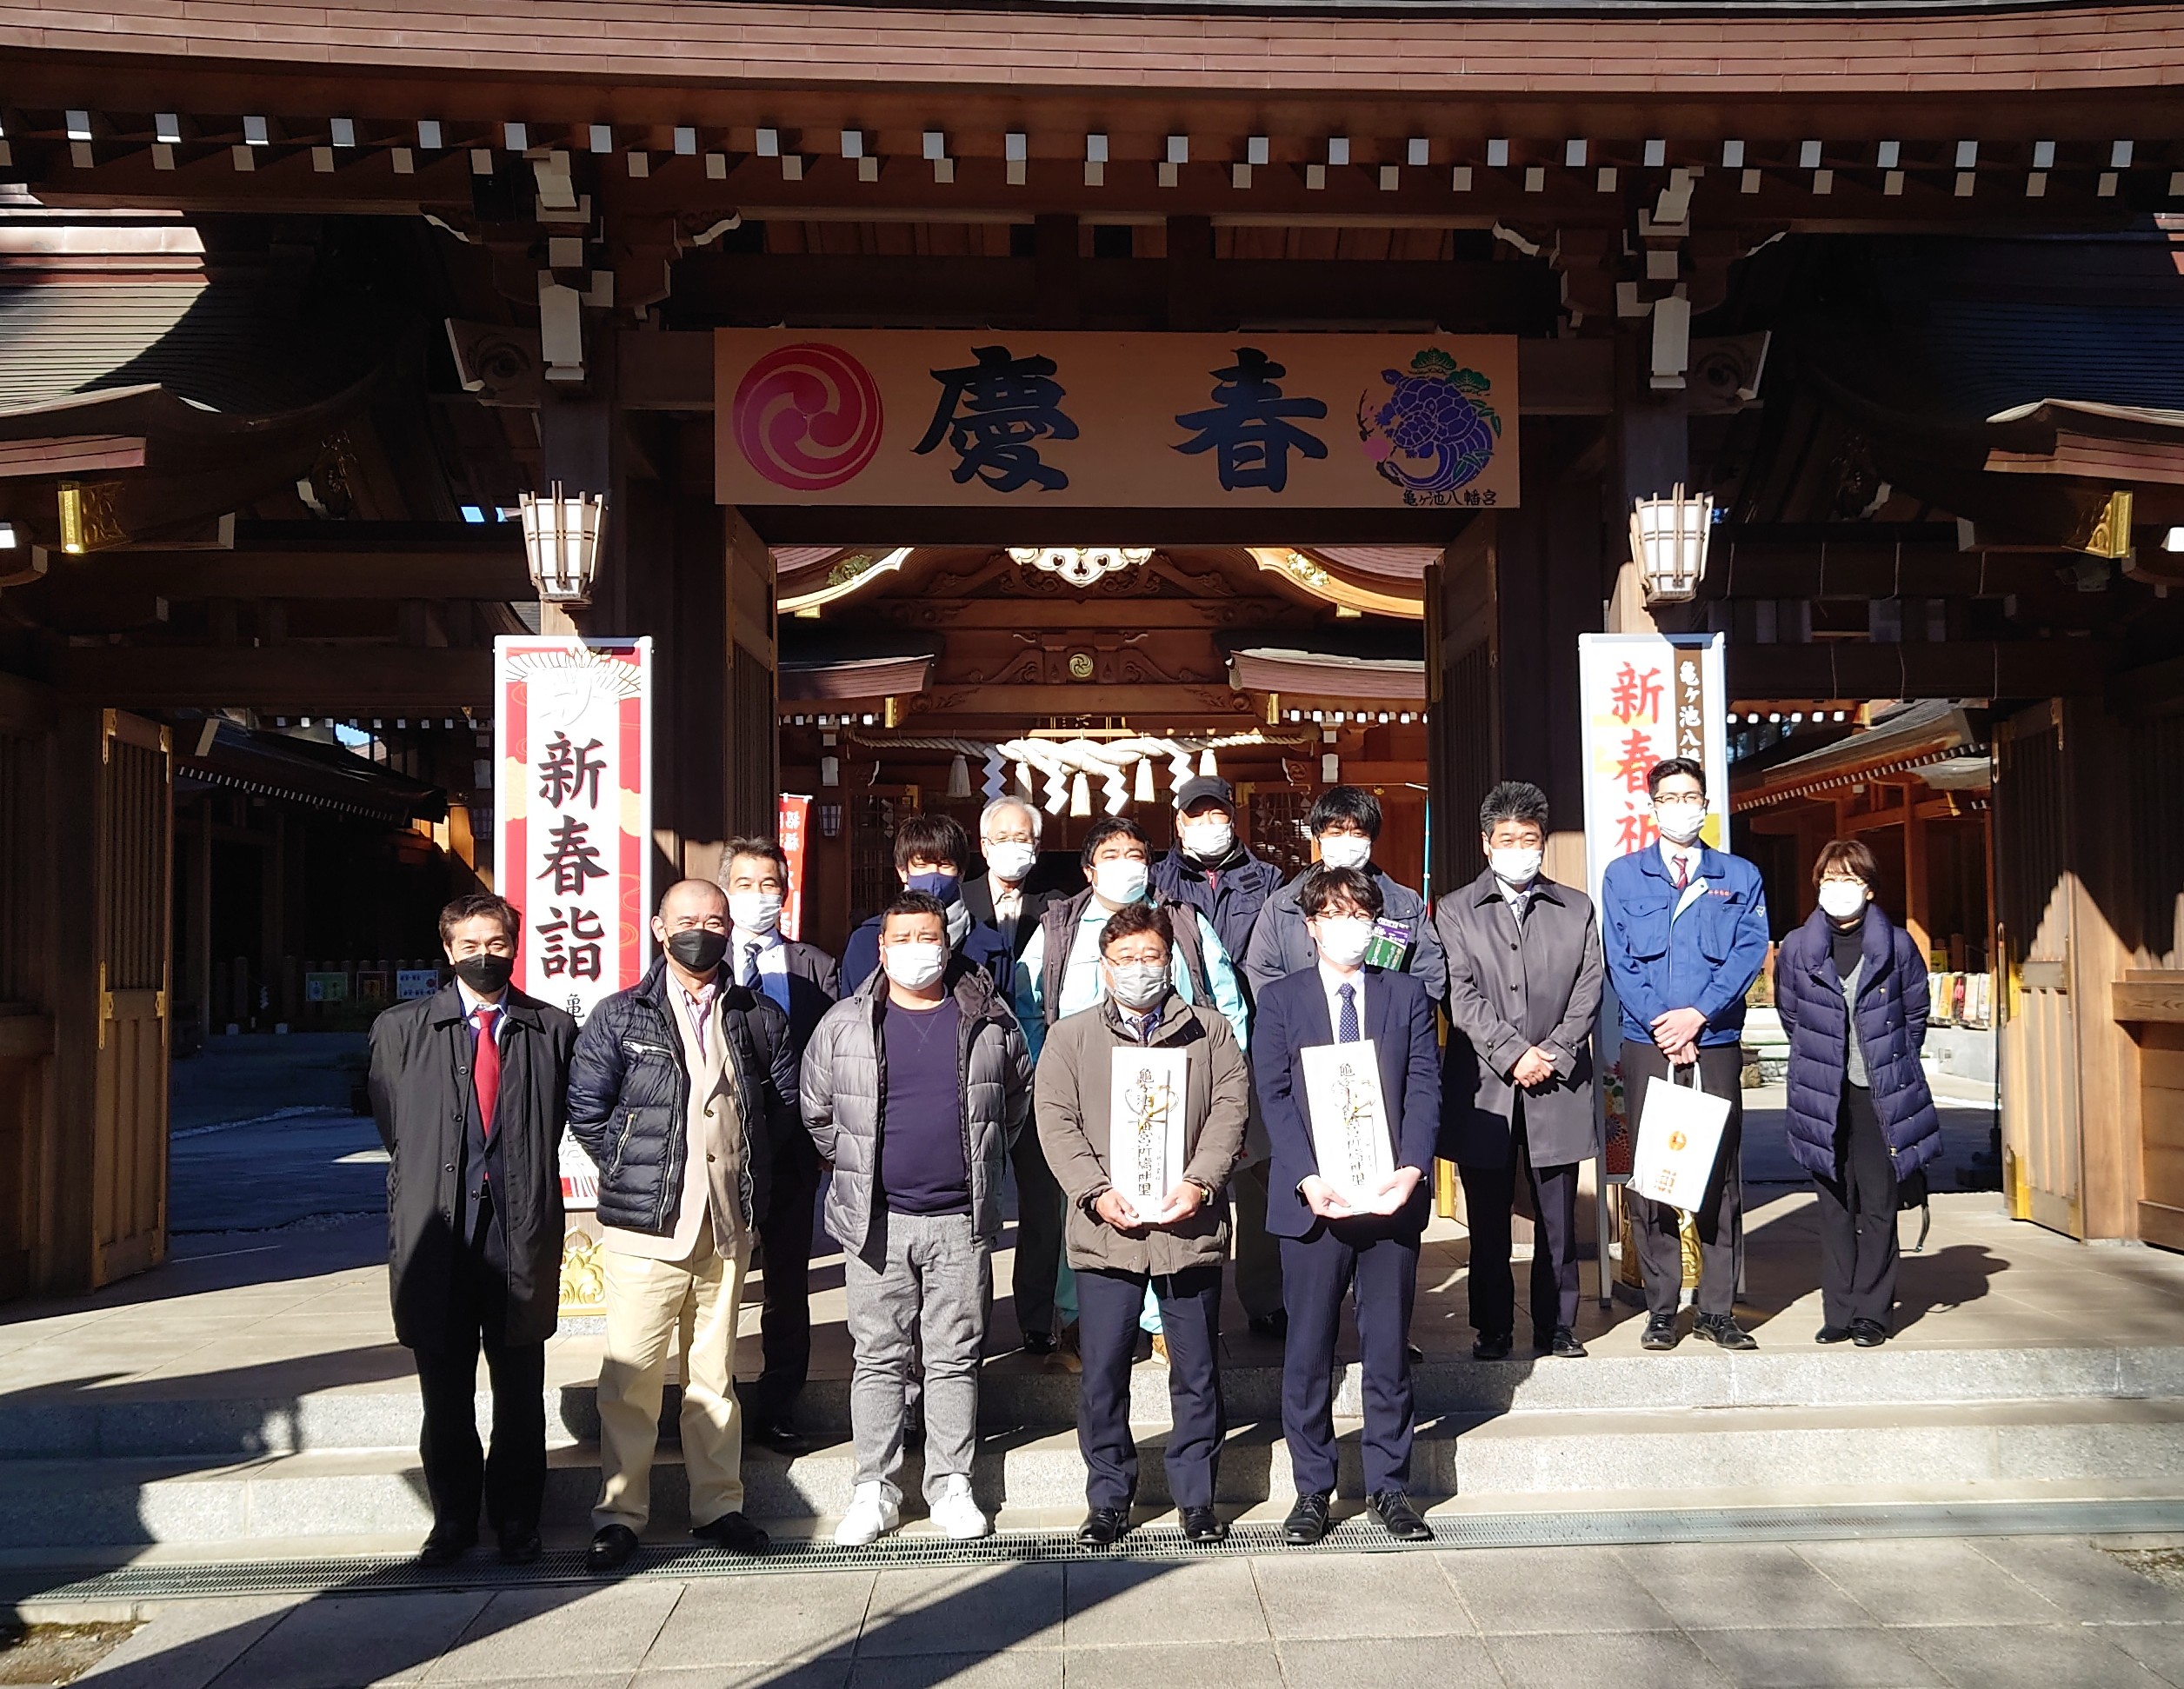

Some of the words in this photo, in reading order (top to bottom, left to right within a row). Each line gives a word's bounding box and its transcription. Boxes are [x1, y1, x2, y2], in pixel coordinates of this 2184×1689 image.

[1403, 489, 1496, 507] 亀ヶ池八幡宮
[536, 731, 609, 981] 新春詣
